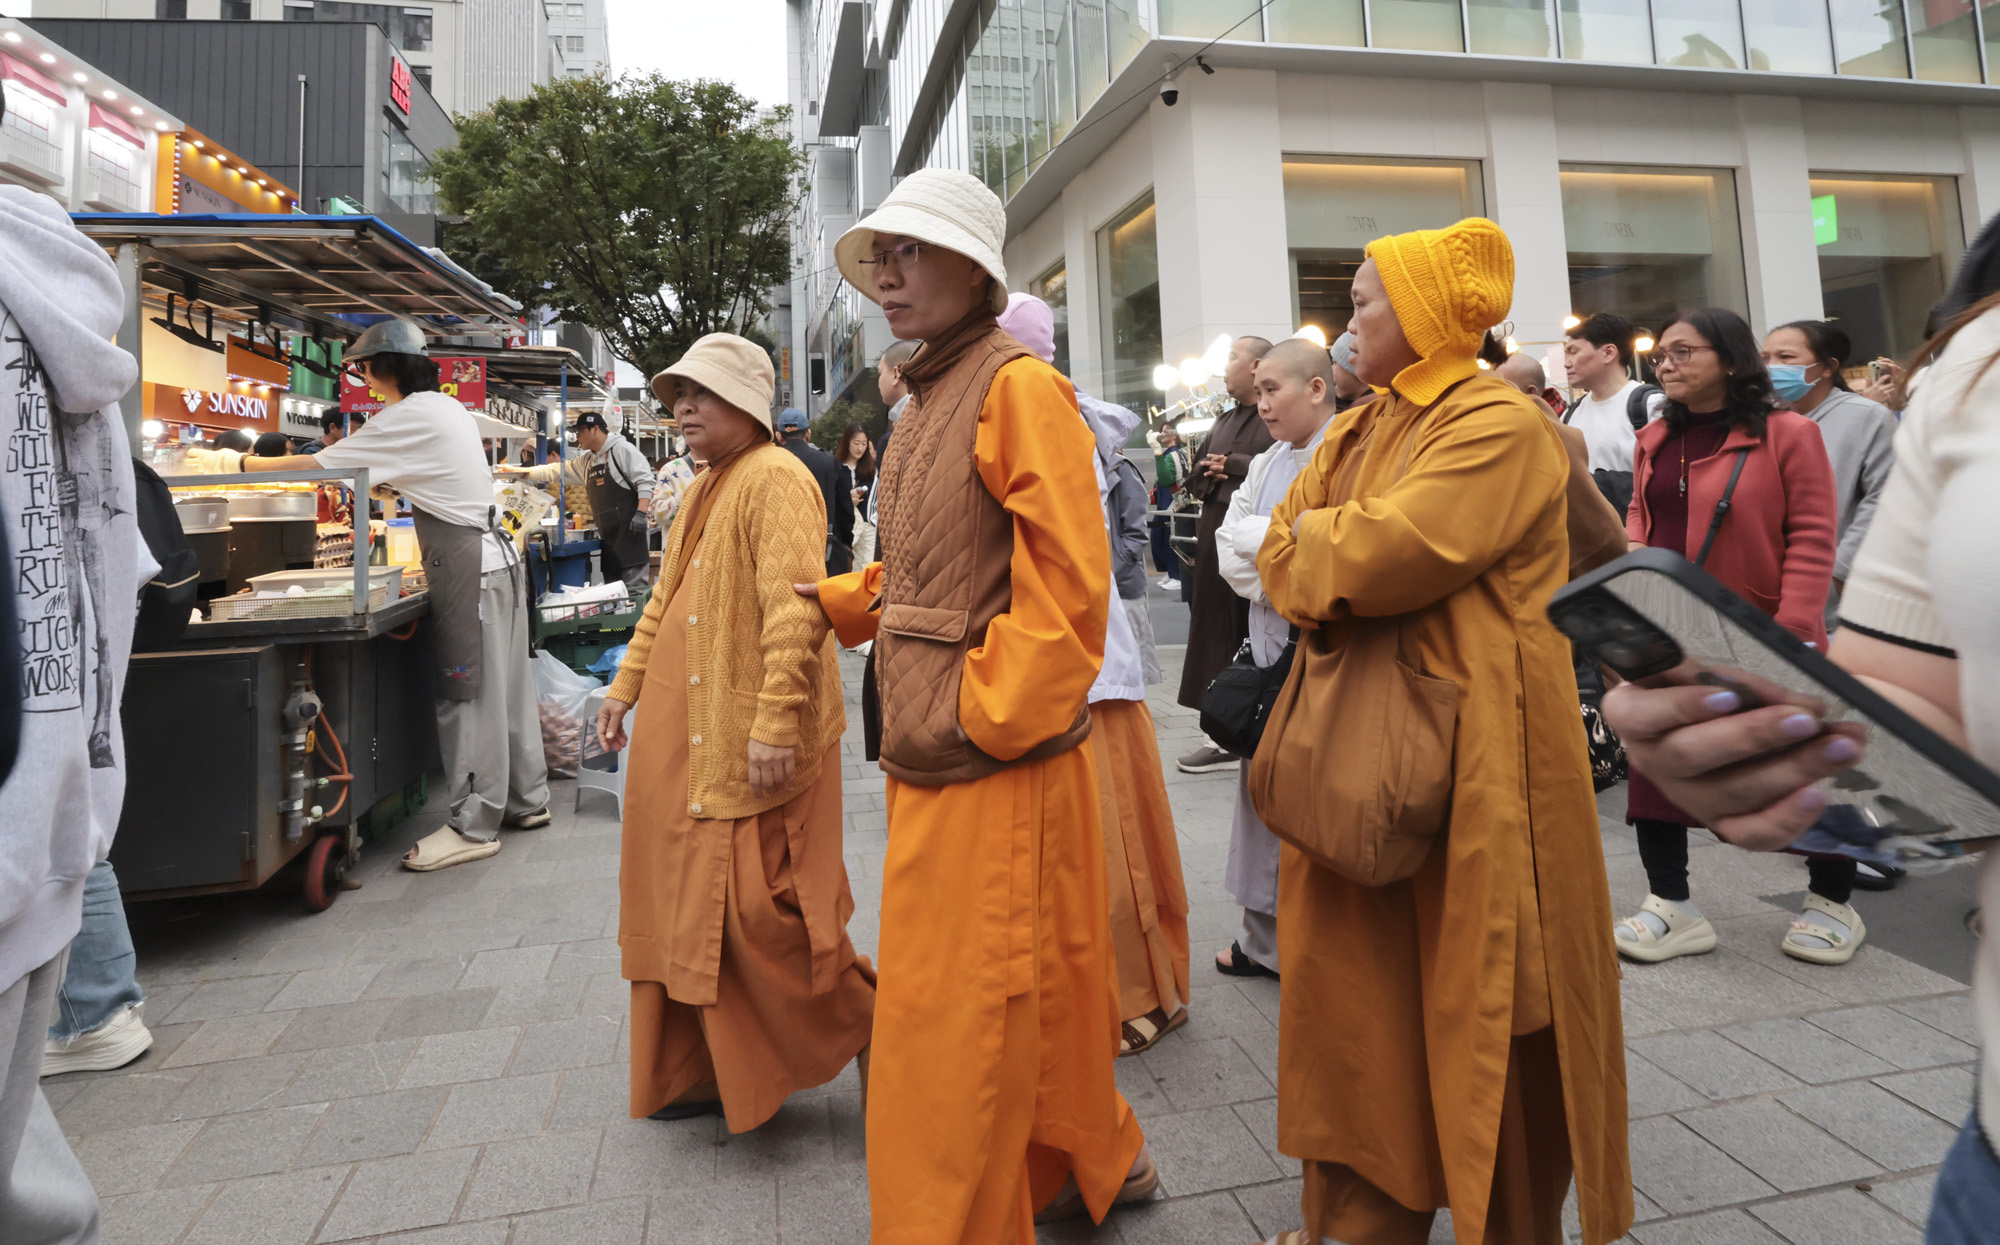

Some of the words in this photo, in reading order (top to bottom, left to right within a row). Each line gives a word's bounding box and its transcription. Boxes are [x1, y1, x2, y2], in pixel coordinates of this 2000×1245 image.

[391, 56, 411, 97] ABC
[208, 391, 267, 420] SUNSKIN
[6, 432, 51, 473] SUI
